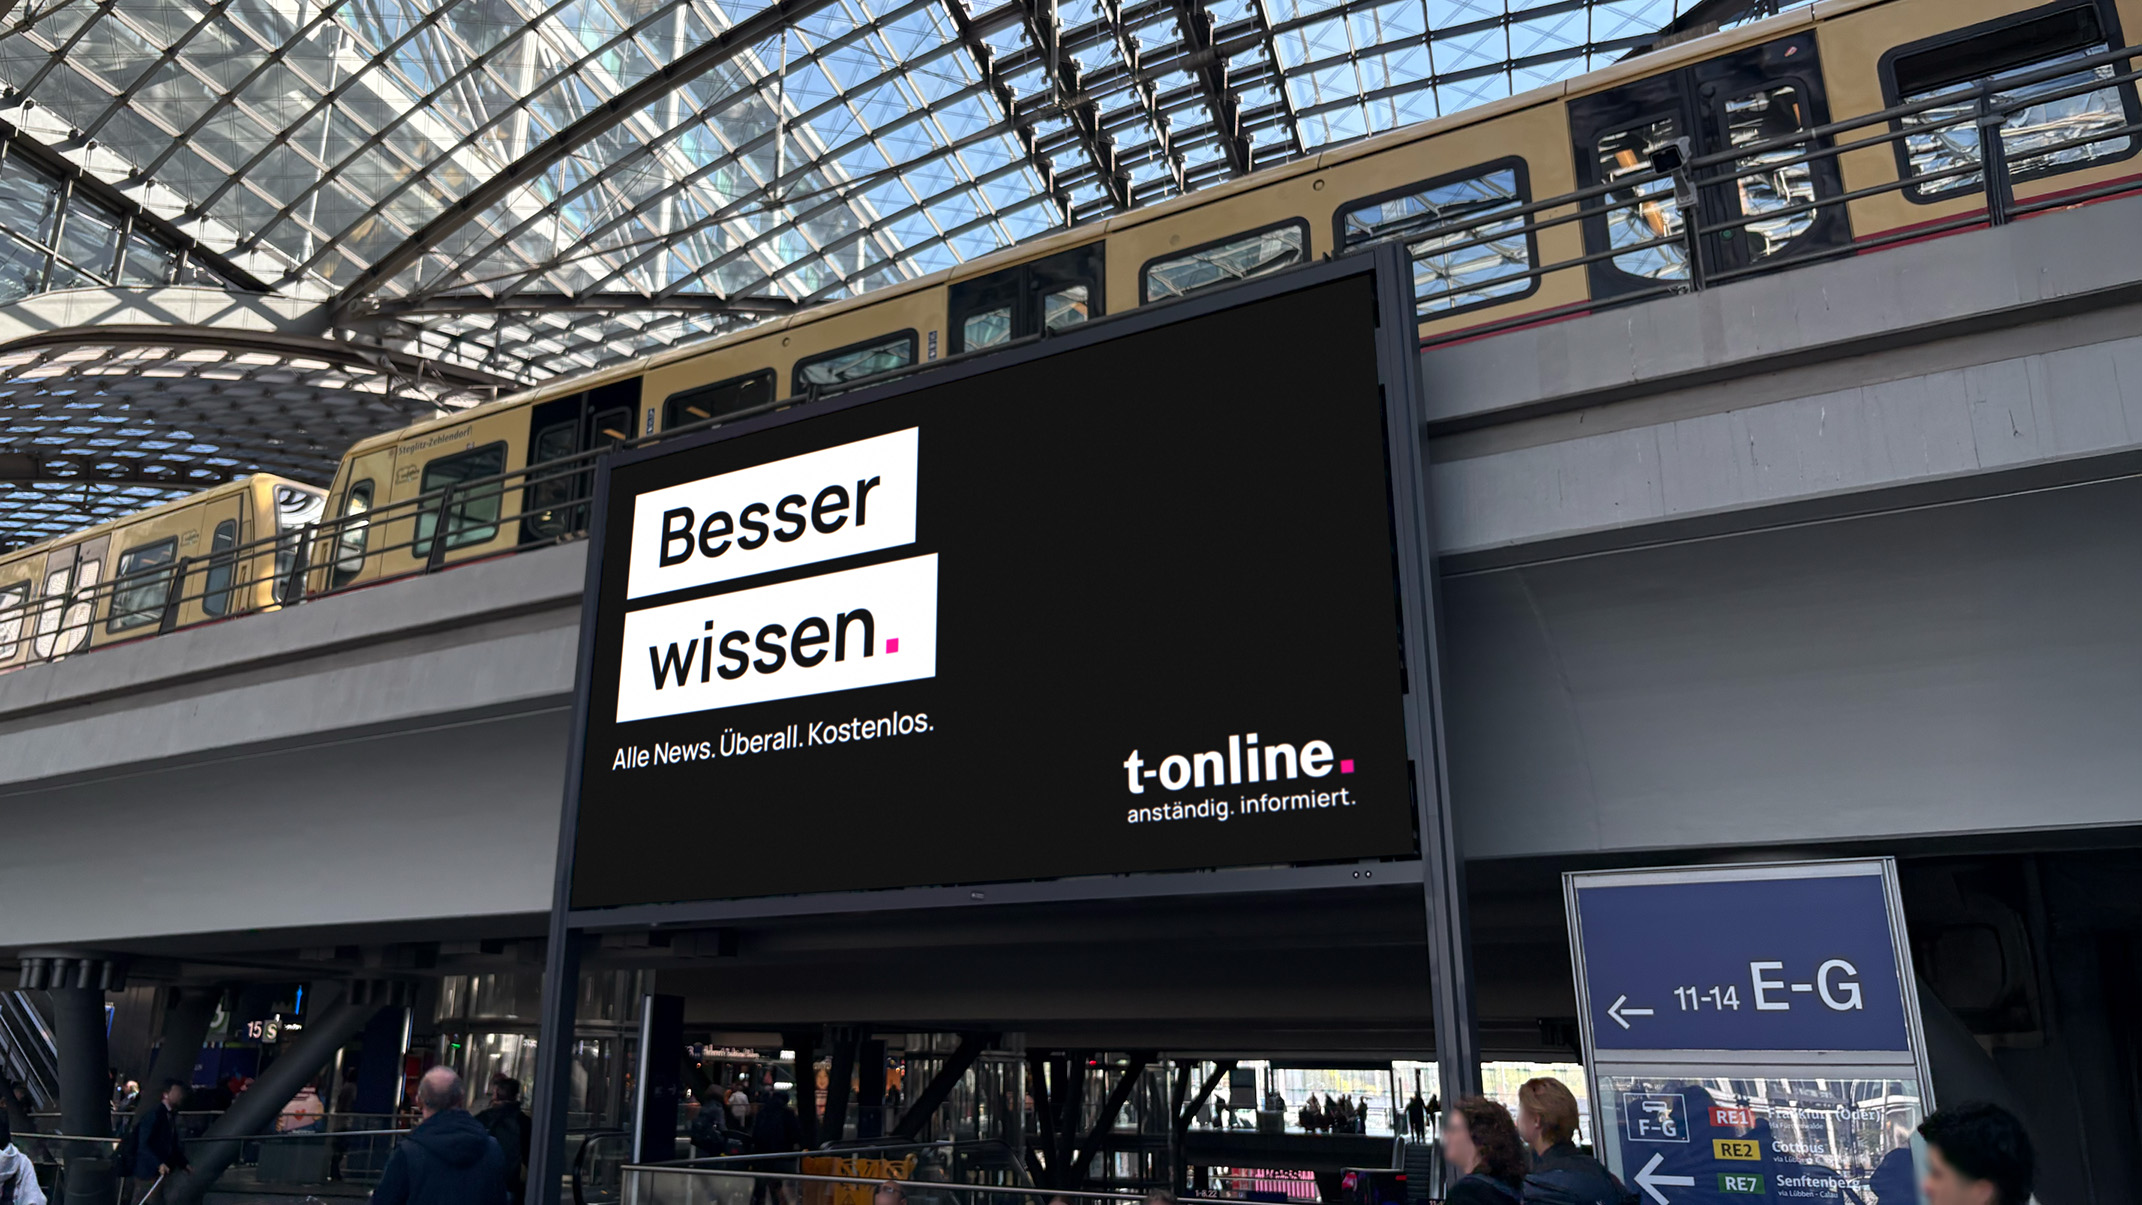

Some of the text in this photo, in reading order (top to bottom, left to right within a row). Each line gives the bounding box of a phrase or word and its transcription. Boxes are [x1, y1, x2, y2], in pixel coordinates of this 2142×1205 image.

[398, 426, 471, 455] Steglitz-Zehlendorf
[659, 475, 880, 568] Besser
[649, 608, 899, 690] wissen.
[612, 711, 934, 771] Alle News. Überall. Kostenlos.
[1123, 733, 1355, 794] t-online.
[1127, 788, 1356, 822] anständig. informiert.
[1673, 958, 1863, 1011] 11-14 E-G
[248, 1021, 262, 1039] 15
[1638, 1118, 1677, 1137] F-G
[1716, 1110, 1749, 1125] RE1
[1835, 1107, 1881, 1122] (Oder)
[1720, 1140, 1825, 1157] RE2 Cottbus
[1725, 1174, 1861, 1191] RE7 Senftenberg
[1789, 1190, 1814, 1198] Lübben
